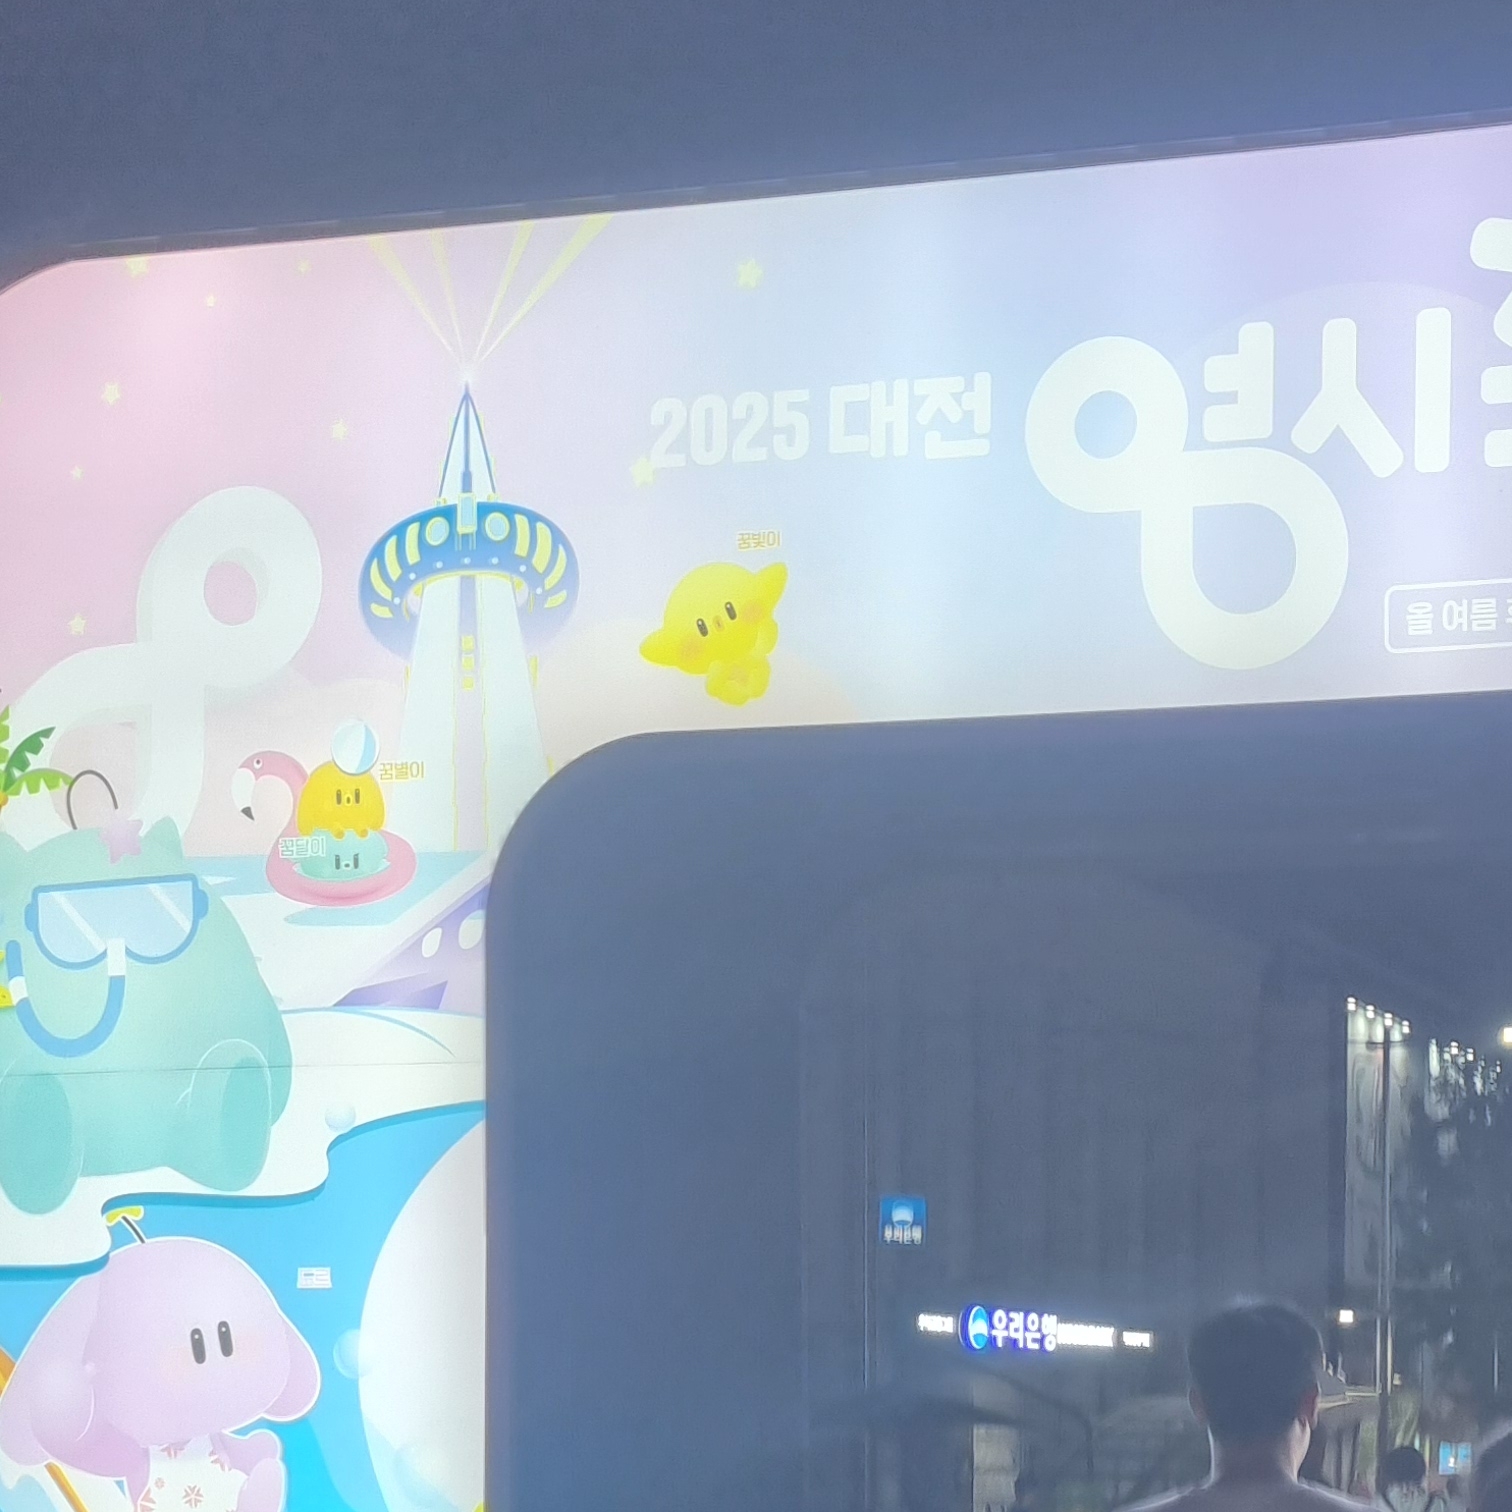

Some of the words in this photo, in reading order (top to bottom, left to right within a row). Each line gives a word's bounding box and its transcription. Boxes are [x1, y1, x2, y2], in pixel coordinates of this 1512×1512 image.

[649, 388, 810, 469] 2025
[828, 371, 992, 460] 대전
[1405, 602, 1433, 636] 올
[1441, 598, 1498, 633] 여름
[378, 761, 425, 782] 꿈별이
[279, 837, 326, 858] 꿈달이
[991, 1308, 1058, 1351] 우리은행
